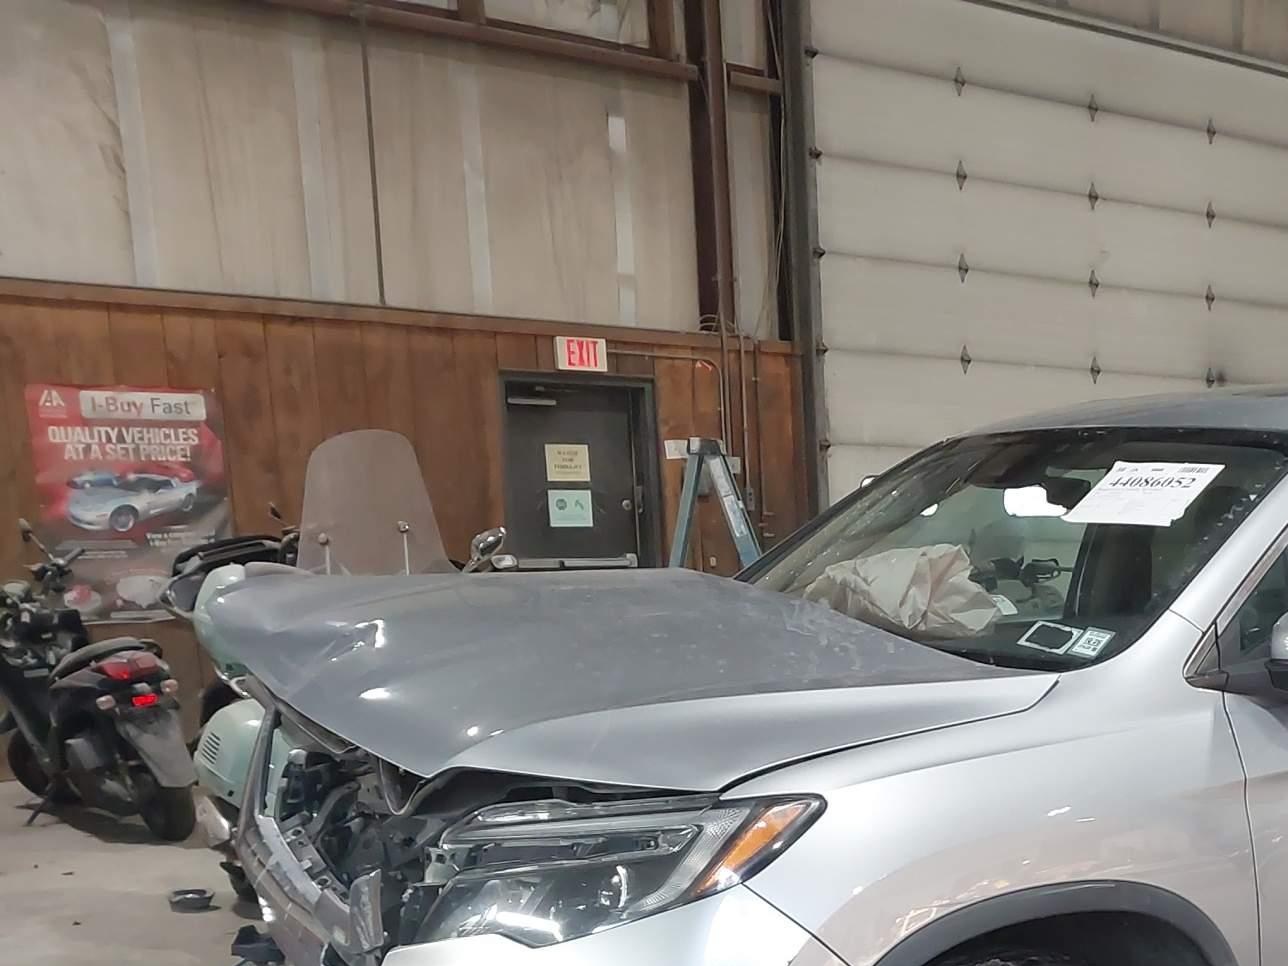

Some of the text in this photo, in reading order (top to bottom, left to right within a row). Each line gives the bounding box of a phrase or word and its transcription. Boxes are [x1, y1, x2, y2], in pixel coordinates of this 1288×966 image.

[566, 338, 599, 369] EXIT
[91, 396, 191, 416] I-Buy Fast
[48, 426, 199, 445] QUALITY VEHICLES
[64, 444, 192, 462] AT A SET PRICE!
[1109, 476, 1196, 488] 44086052
